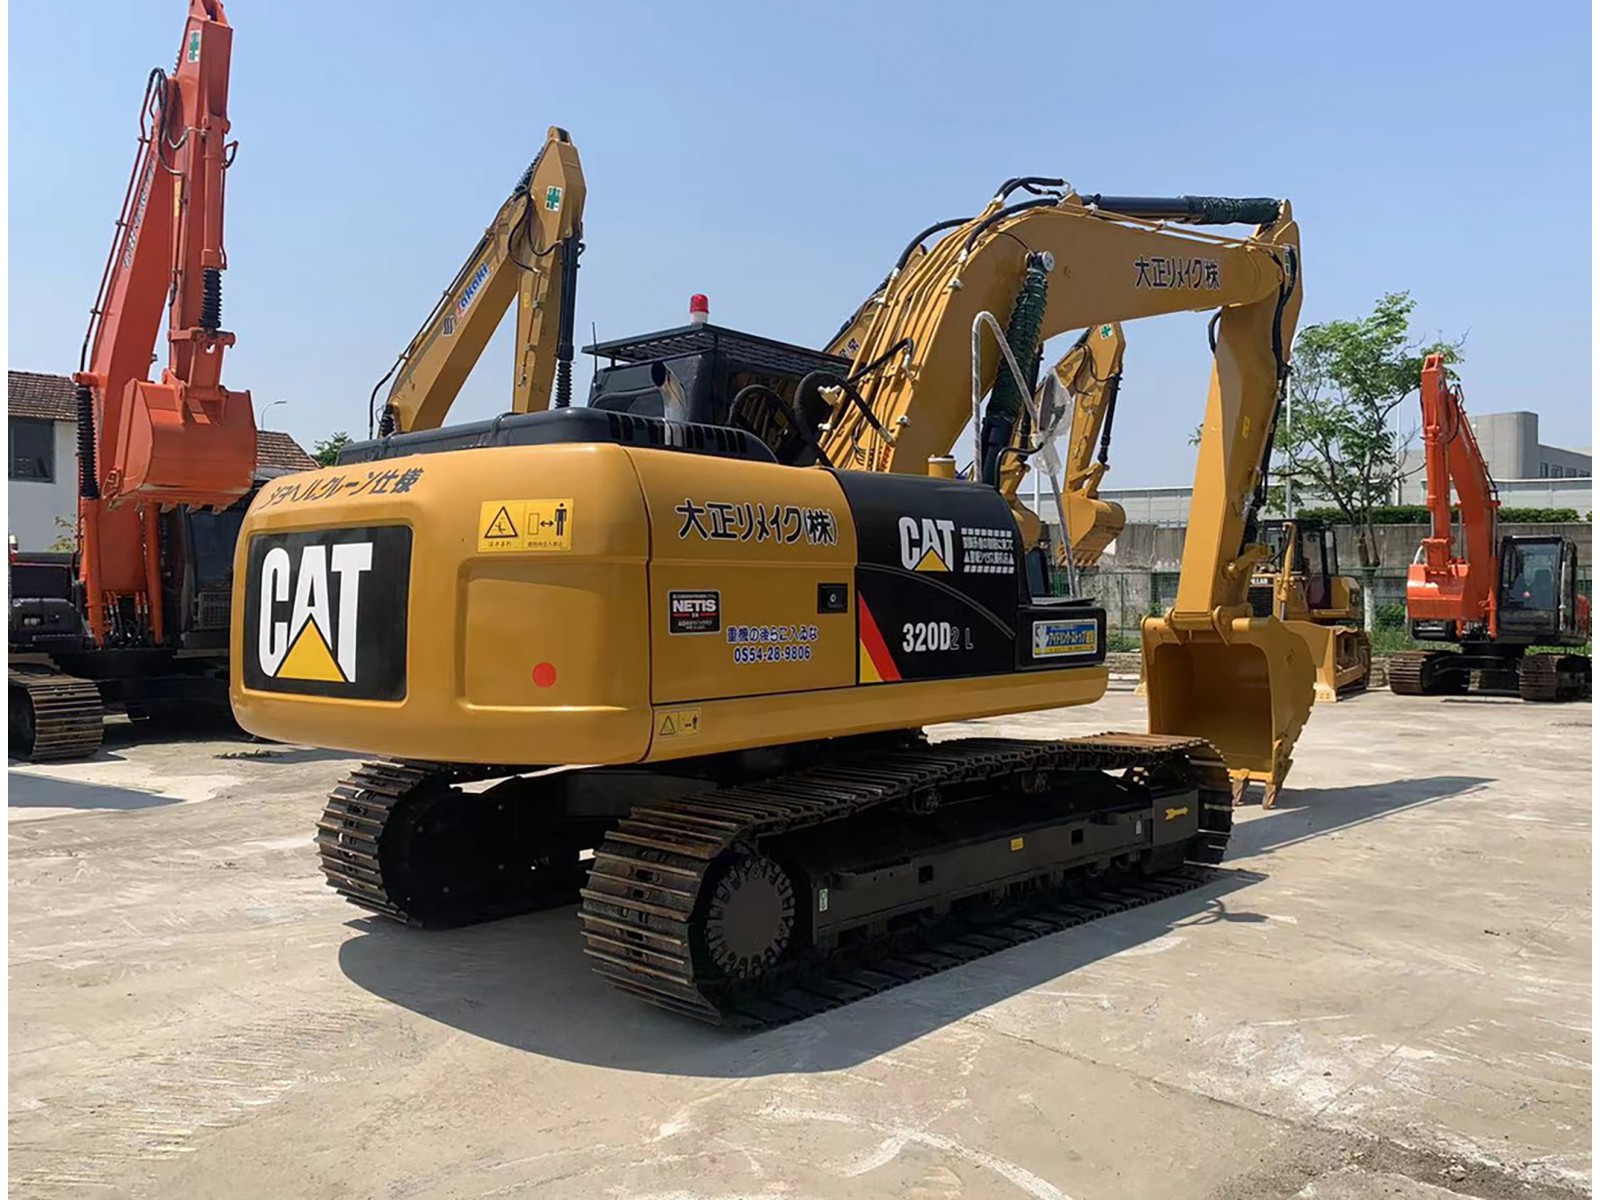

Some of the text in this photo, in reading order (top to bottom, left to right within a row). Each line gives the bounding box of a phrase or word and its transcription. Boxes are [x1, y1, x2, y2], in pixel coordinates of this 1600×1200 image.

[675, 498, 838, 547] 大正リメイク(株)
[898, 516, 955, 572] CAT
[258, 542, 373, 683] CAT
[672, 599, 717, 612] NETIS
